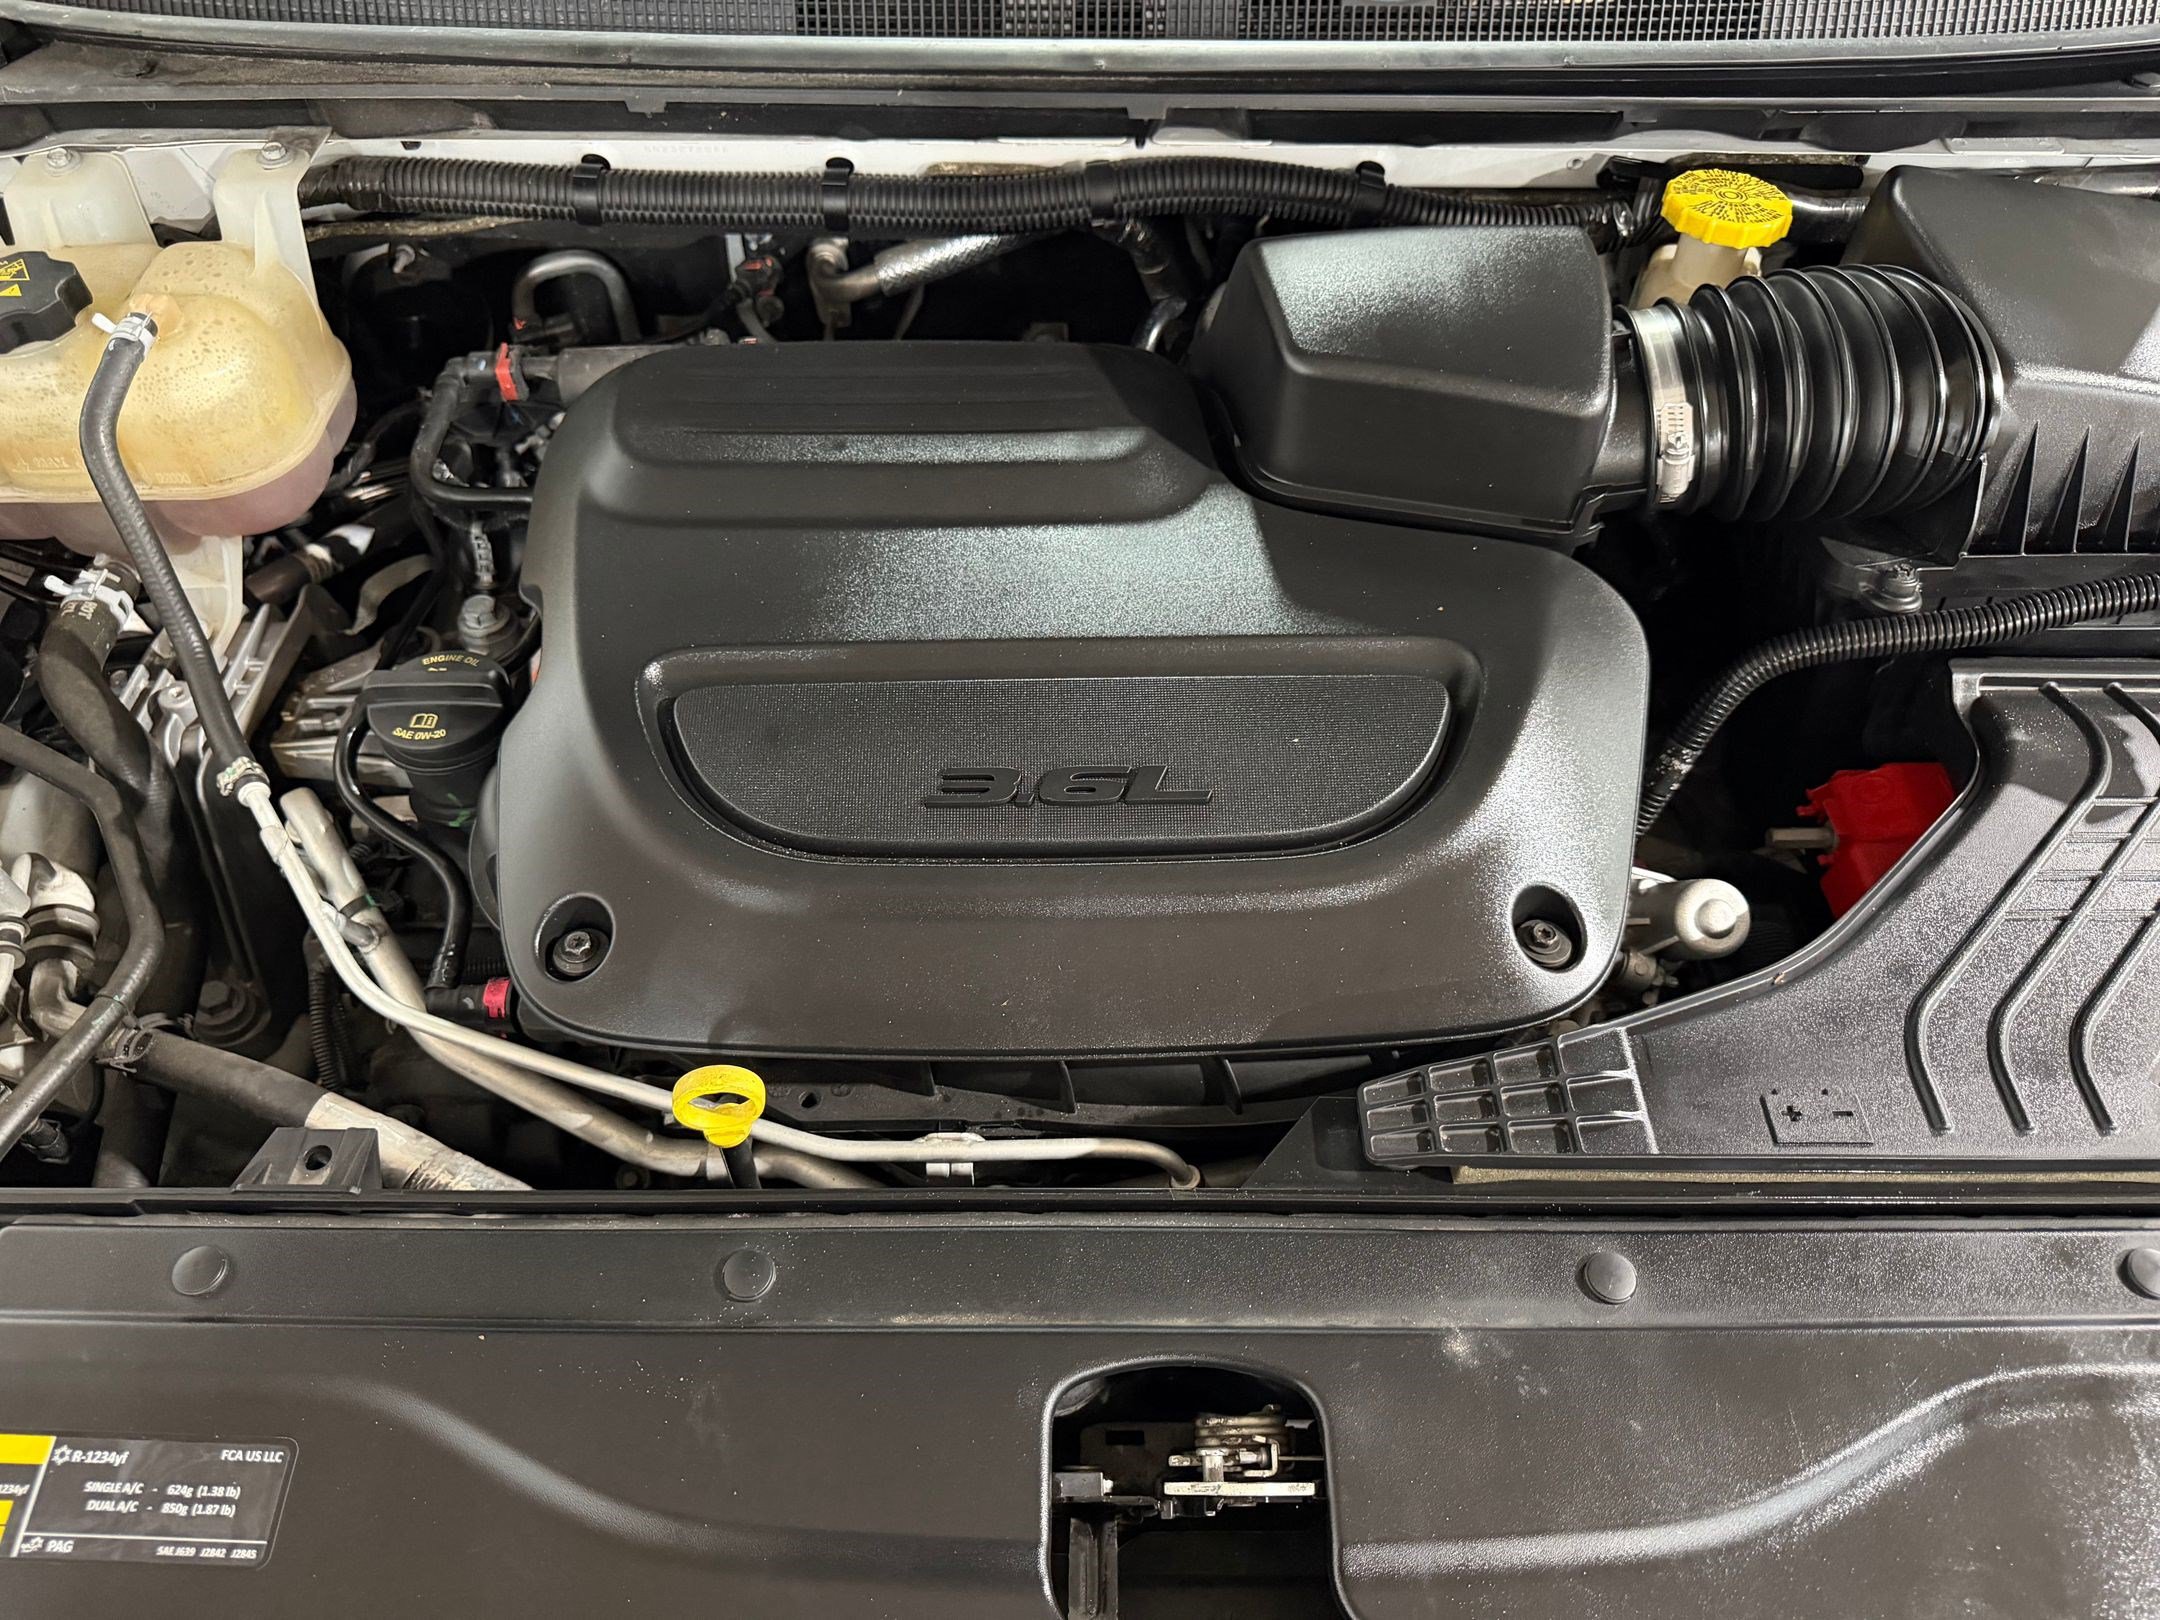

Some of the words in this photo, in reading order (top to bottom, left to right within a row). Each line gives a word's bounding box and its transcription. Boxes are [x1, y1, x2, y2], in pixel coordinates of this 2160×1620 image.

[422, 654, 464, 666] ENGINE
[463, 656, 480, 667] OIL
[392, 727, 415, 740] SAE
[414, 728, 447, 740] 0W-20
[924, 764, 1213, 809] 3.6L
[71, 1450, 129, 1466] R-1234yf
[221, 1449, 244, 1461] FCA
[245, 1451, 262, 1463] US
[263, 1452, 284, 1463] LLC
[83, 1481, 123, 1493] SINGLE
[121, 1483, 145, 1495] A/C
[166, 1484, 194, 1498] 624g
[197, 1485, 225, 1498] (1.38
[225, 1486, 241, 1500] lb)
[85, 1500, 116, 1511] DUAL
[116, 1501, 140, 1514] A/C
[161, 1503, 189, 1516] 850g
[191, 1503, 220, 1517] (1.87
[220, 1505, 236, 1518] lb)
[46, 1540, 74, 1553] PAG
[156, 1546, 175, 1556] SAE
